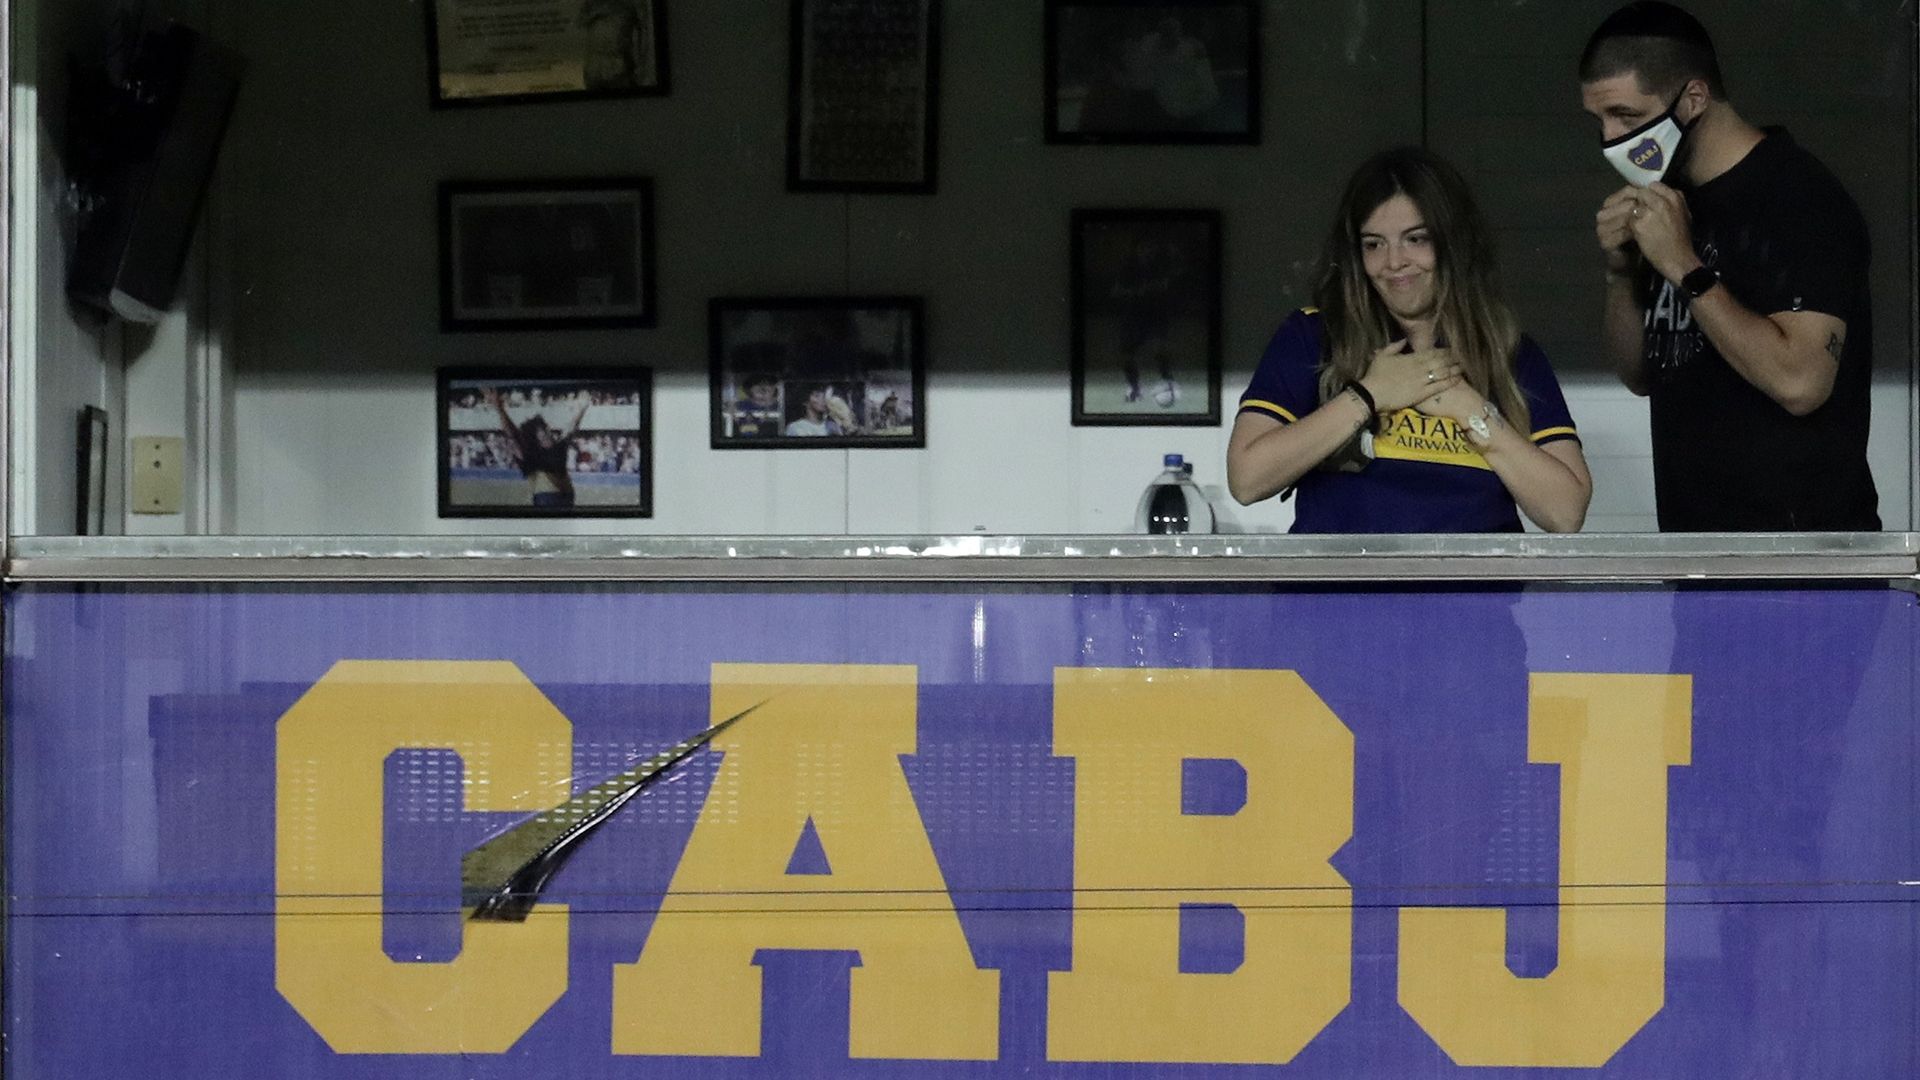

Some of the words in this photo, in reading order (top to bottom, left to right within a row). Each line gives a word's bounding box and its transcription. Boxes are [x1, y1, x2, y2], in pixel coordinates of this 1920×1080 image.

[1634, 144, 1660, 165] CABJ
[1396, 435, 1471, 454] AIRWAYS
[276, 659, 1692, 1067] CABJ
